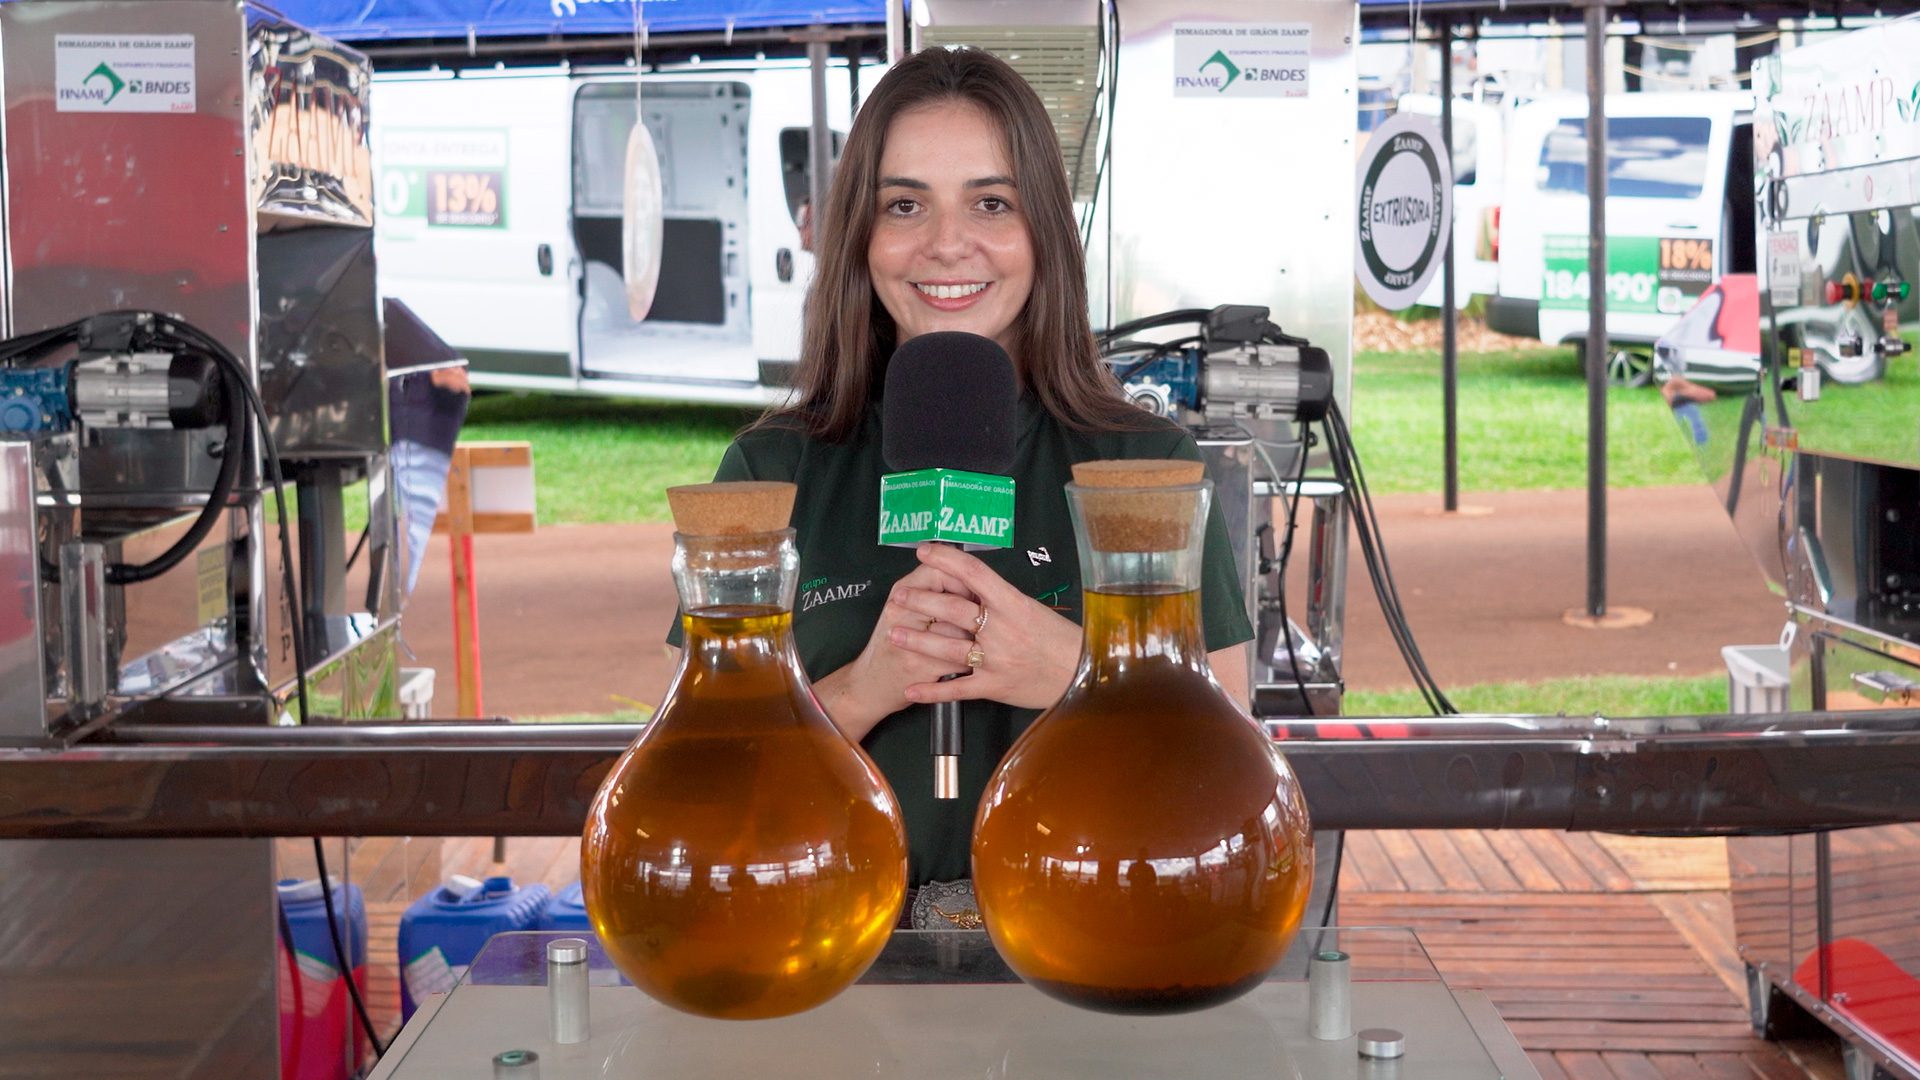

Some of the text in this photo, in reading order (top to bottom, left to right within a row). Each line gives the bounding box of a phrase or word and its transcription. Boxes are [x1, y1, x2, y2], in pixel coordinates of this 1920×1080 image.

[1175, 28, 1233, 36] ESMAGADORA
[58, 40, 116, 49] ESMAGADORA
[119, 41, 130, 49] DE
[1175, 77, 1221, 88] FINAME
[1260, 69, 1306, 81] BNDES
[145, 82, 191, 94] BNDES
[1804, 77, 1894, 143] ZAAMP
[1393, 137, 1424, 152] ZAAMP
[433, 173, 497, 214] 13%
[1361, 184, 1372, 242] ZAAMP
[1373, 196, 1430, 227] EXTRUSORA
[1660, 239, 1713, 270] 18%
[881, 510, 933, 534] ZAAMP
